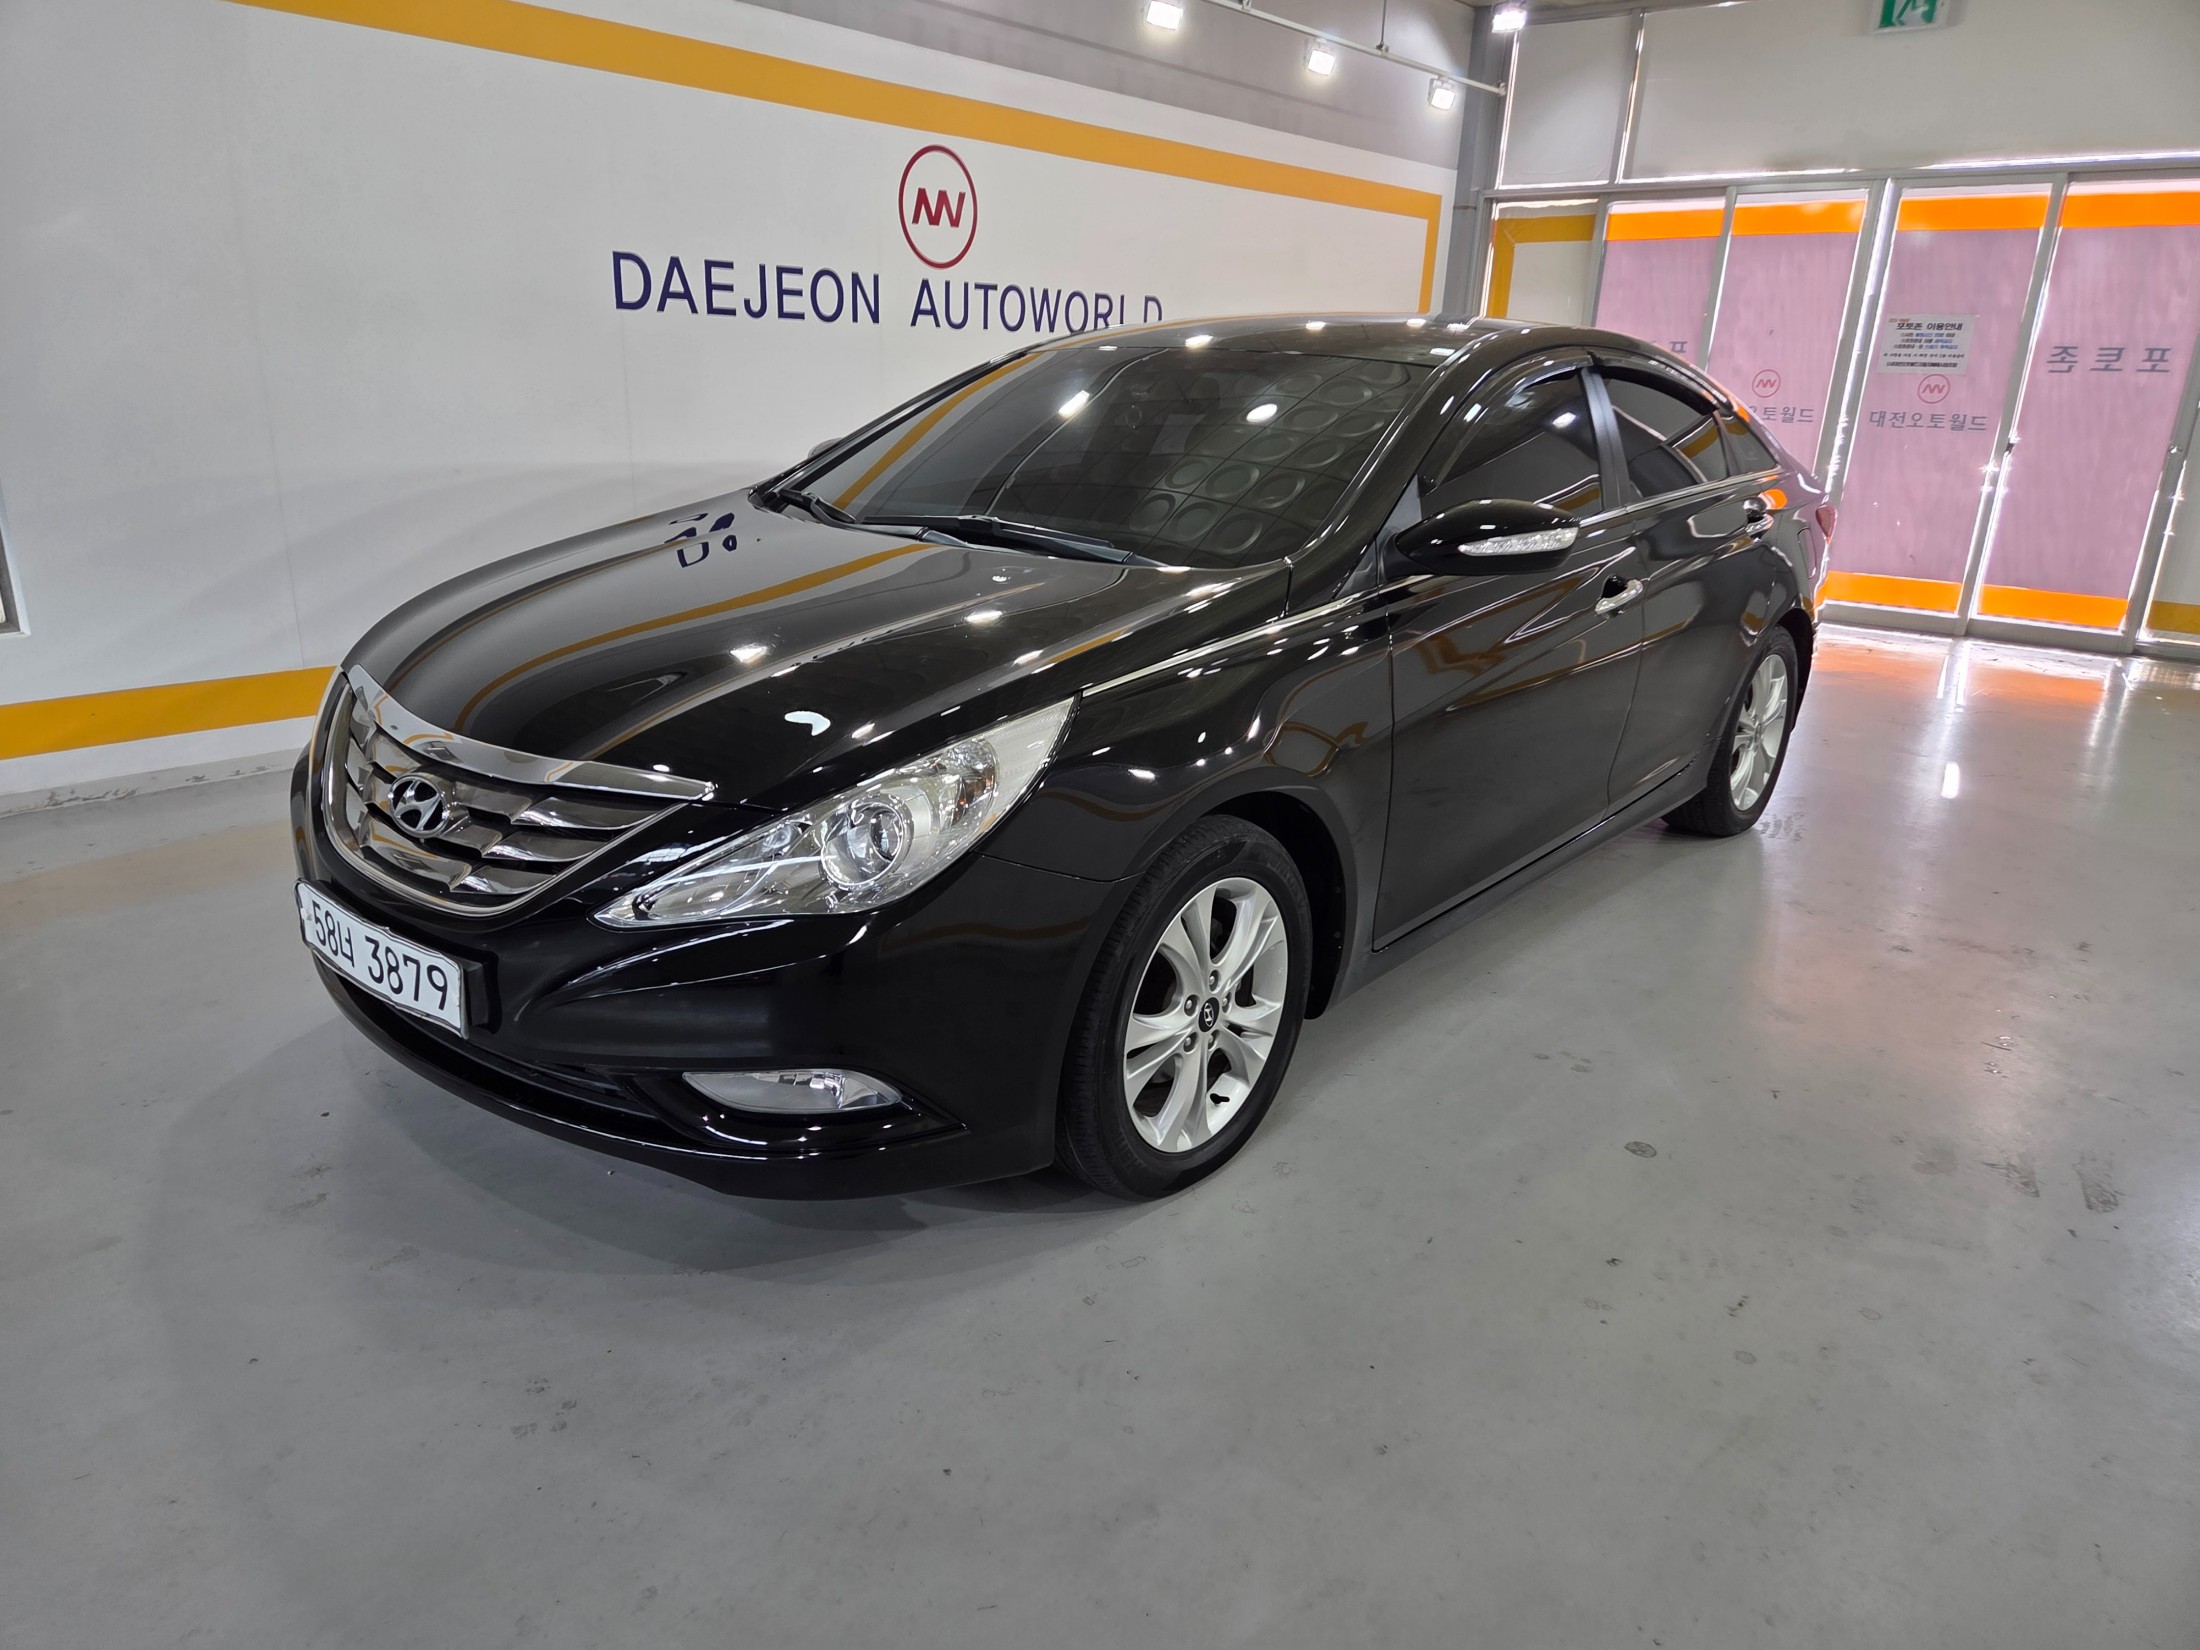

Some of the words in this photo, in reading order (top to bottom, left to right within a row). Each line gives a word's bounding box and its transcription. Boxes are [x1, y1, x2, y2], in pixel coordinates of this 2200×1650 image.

[612, 250, 880, 324] DAEJEON
[1869, 410, 1988, 432] 대전오토월드
[312, 900, 355, 968] 58너
[364, 934, 448, 1011] 3879
